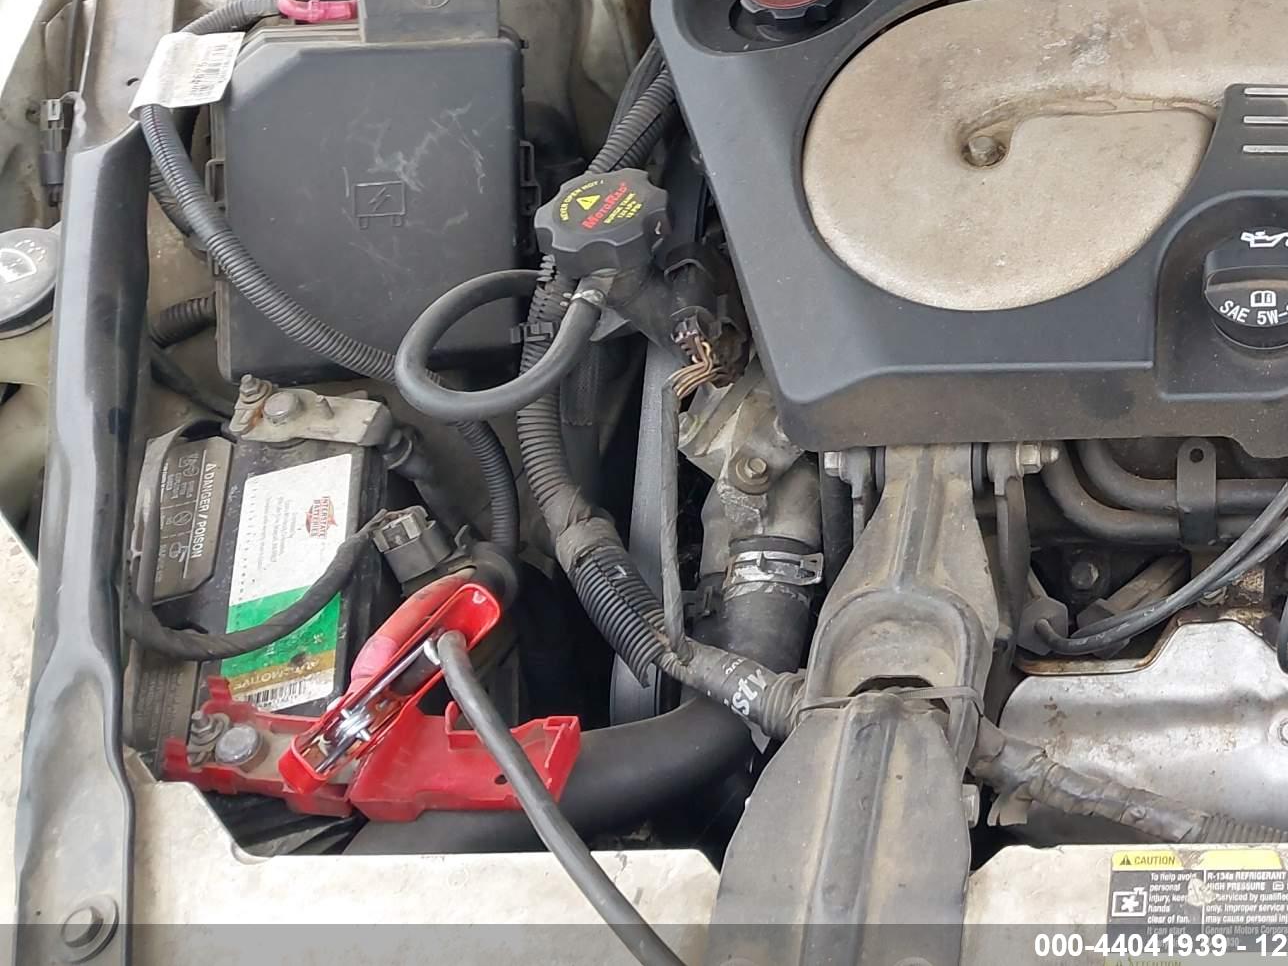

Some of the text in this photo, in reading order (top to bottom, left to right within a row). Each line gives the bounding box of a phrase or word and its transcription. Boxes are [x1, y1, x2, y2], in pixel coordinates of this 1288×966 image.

[1220, 300, 1250, 323] SAE
[200, 474, 215, 515] DANGER
[320, 495, 329, 539] INTERSTATE
[191, 520, 207, 558] POISON
[1134, 855, 1176, 865] CAUTION
[1151, 873, 1159, 881] To
[1160, 872, 1176, 882] help
[1207, 871, 1233, 881] R-134a
[1235, 871, 1287, 881] REFRIGERANT
[1149, 883, 1180, 894] personal
[1226, 882, 1266, 891] PRESSURE
[1148, 894, 1170, 906] injury,
[1249, 893, 1258, 903] by
[1148, 904, 1170, 913] hands
[1205, 904, 1222, 914] only.
[1224, 904, 1257, 914] Improper
[1258, 904, 1286, 912] service
[1147, 915, 1190, 924] clear of fan.
[1205, 915, 1220, 925] may
[1222, 915, 1244, 923] cause
[1246, 915, 1278, 925] personal
[1205, 925, 1232, 934] General
[1234, 925, 1258, 934] Motors
